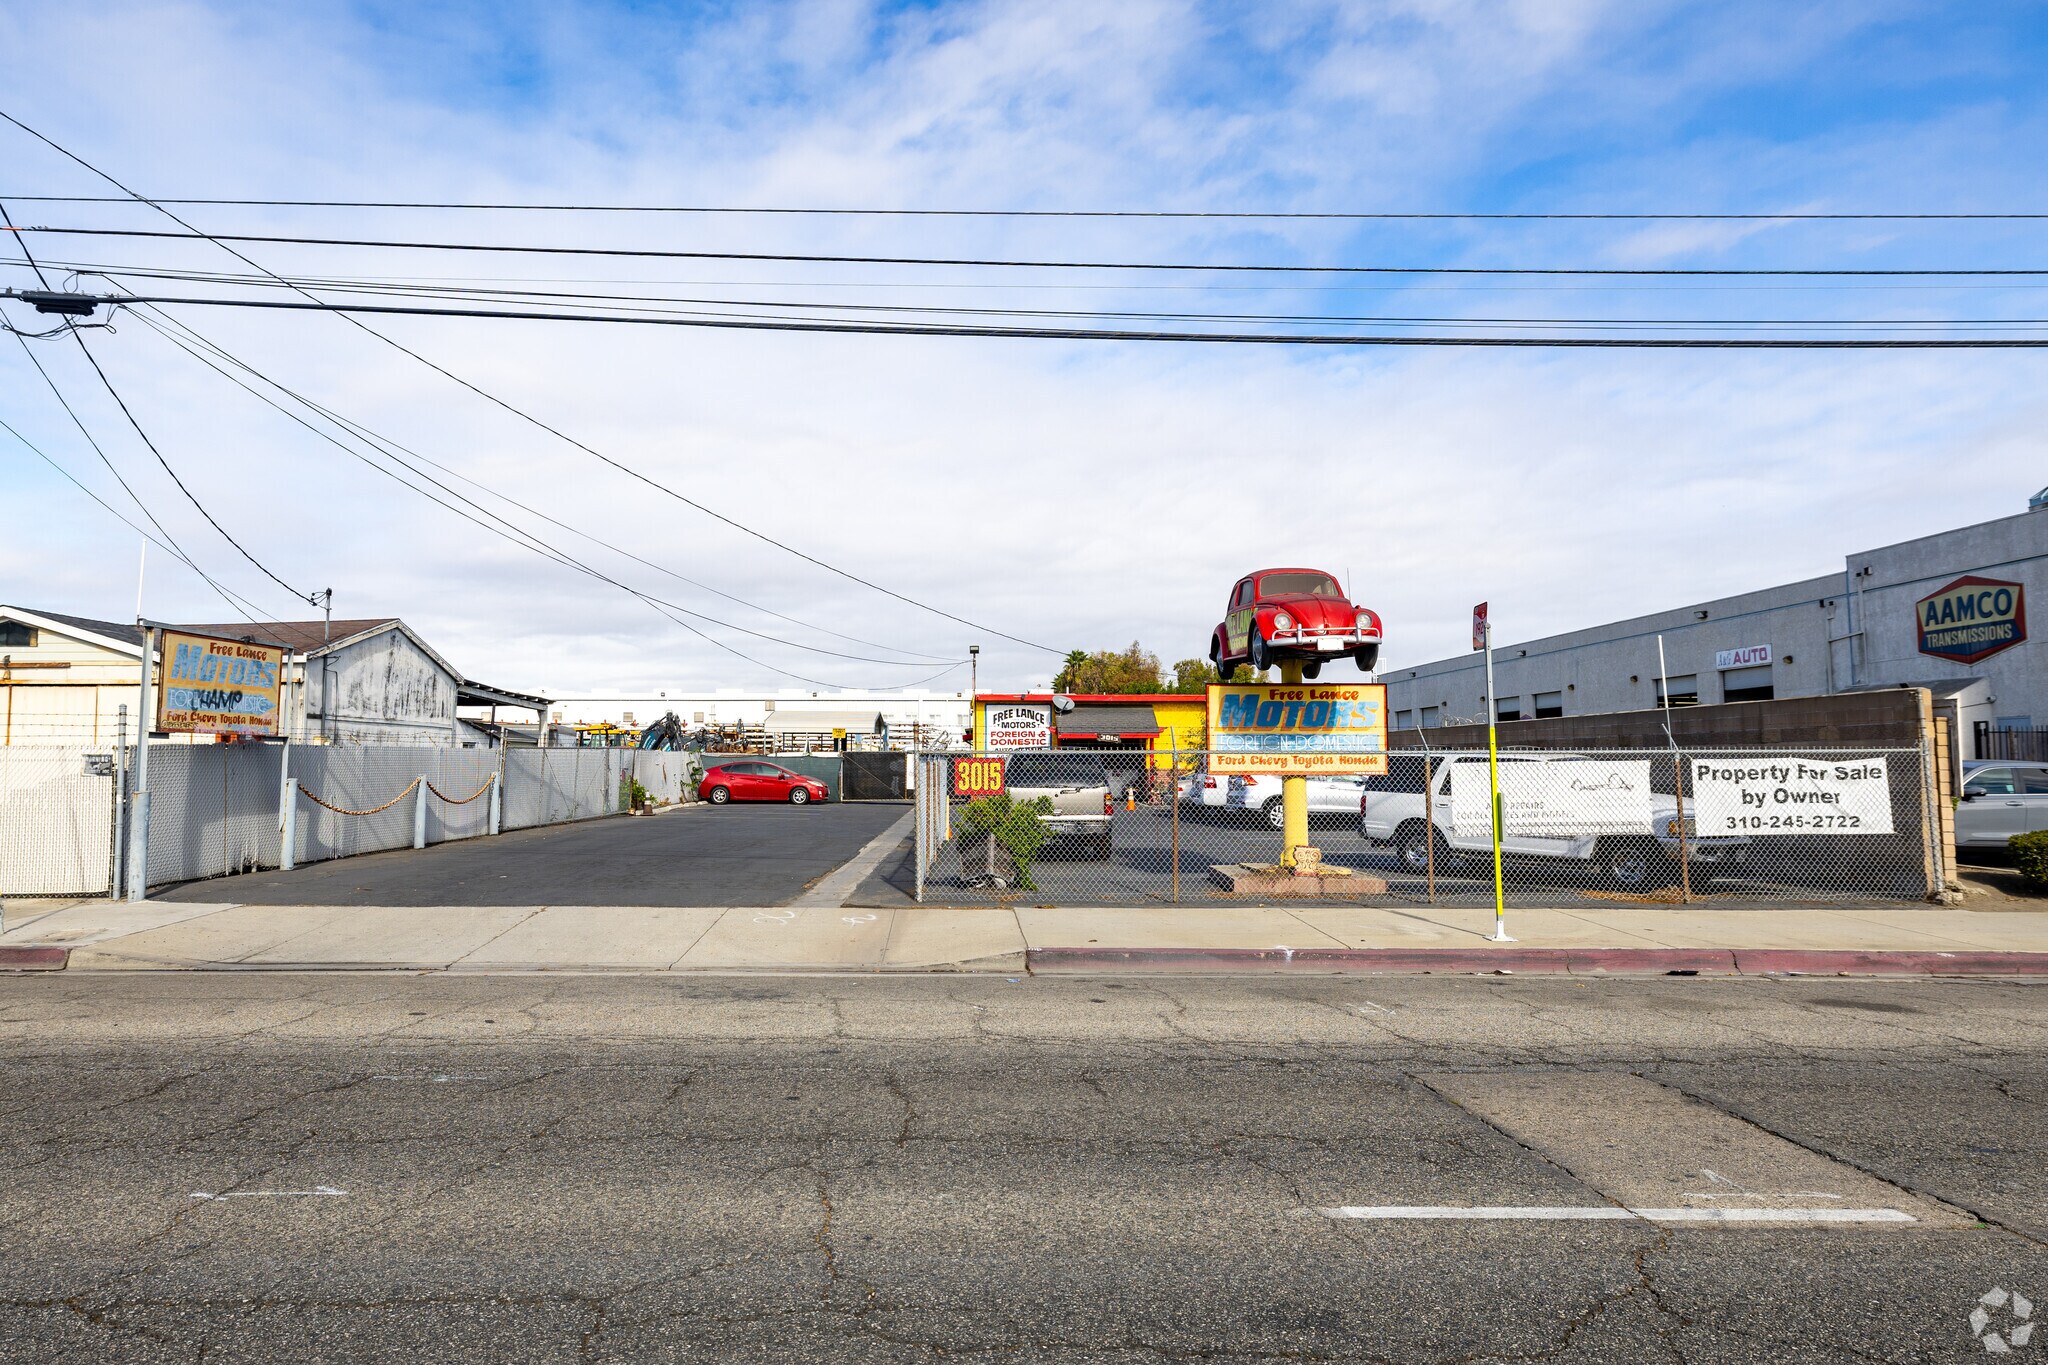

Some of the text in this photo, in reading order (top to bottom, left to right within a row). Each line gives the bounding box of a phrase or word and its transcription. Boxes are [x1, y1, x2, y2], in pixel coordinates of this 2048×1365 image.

[1924, 588, 2013, 627] AAMCO
[1926, 623, 2013, 648] TRANSMISSIONS
[210, 642, 267, 661] Free Lance
[1733, 647, 1768, 664] AUTO
[1269, 689, 1359, 700] Free Lance
[166, 711, 187, 722] Ford
[190, 711, 217, 723] Chevy
[220, 714, 246, 724] Toyota
[993, 708, 1045, 725] FREE LANCE
[1217, 755, 1378, 768] Ford Chevy Toyota Honda
[958, 762, 1001, 791] 3015
[1697, 764, 1882, 784] Property For Sale
[1741, 788, 1841, 808] by Owner
[1726, 816, 1861, 829] 310-245-2722
